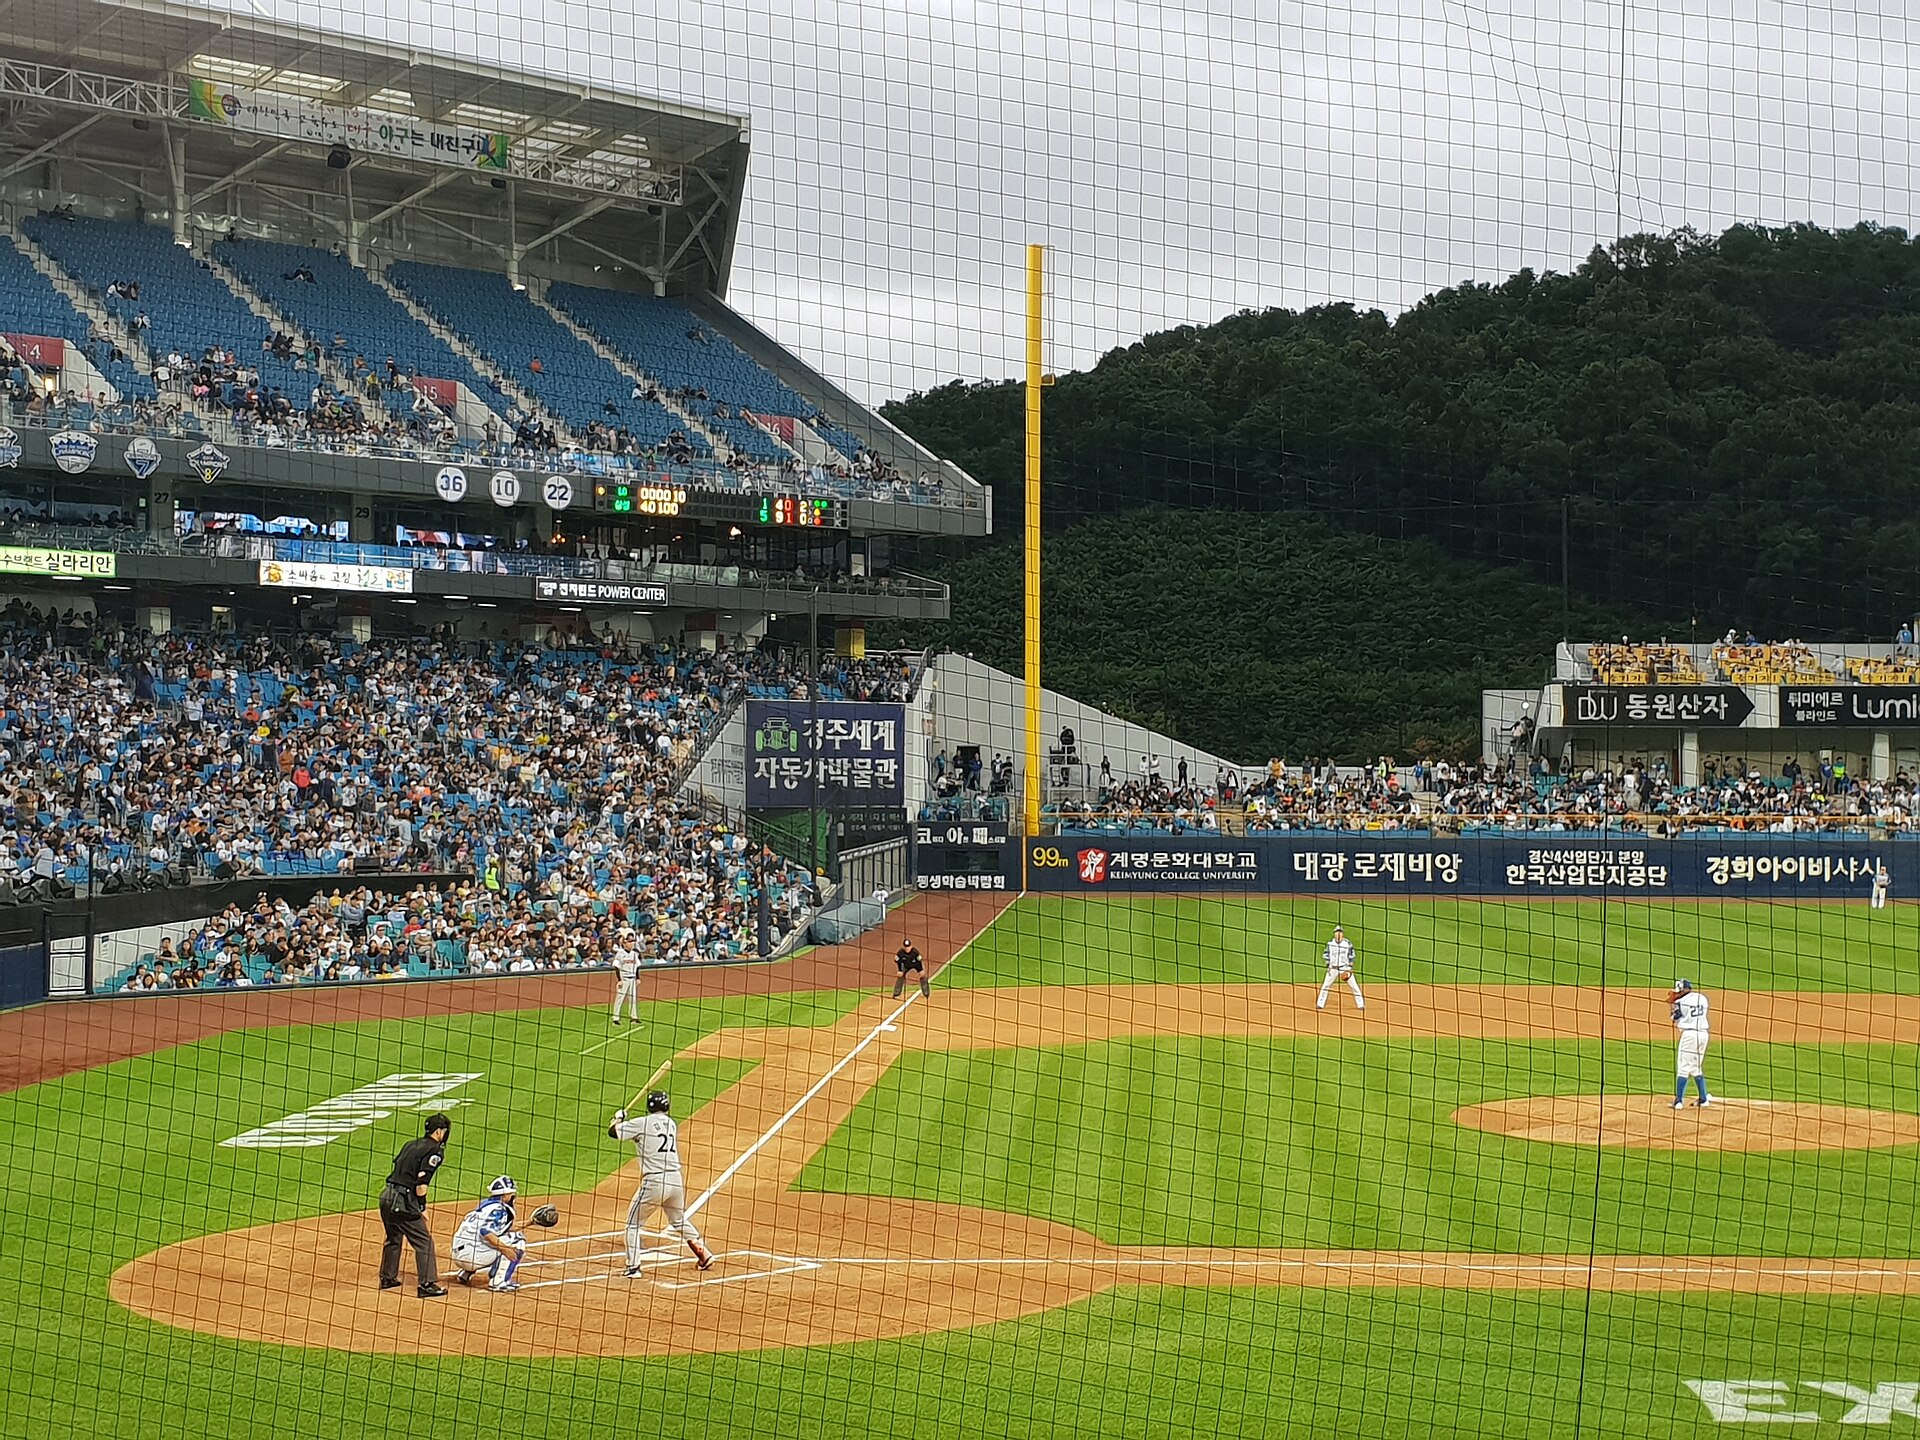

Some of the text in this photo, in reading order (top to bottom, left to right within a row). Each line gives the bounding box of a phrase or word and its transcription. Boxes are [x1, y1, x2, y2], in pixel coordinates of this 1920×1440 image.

[378, 124, 425, 147] 야구는
[21, 343, 42, 360] 14
[422, 384, 438, 400] 15
[440, 474, 463, 493] 36
[495, 478, 515, 497] 10
[547, 483, 569, 501] 22
[153, 492, 170, 504] 27
[355, 506, 370, 519] 29
[45, 552, 112, 574] 실라리안
[598, 584, 631, 599] POWER
[631, 586, 666, 602] CENTER
[1625, 693, 1729, 721] 동원산자
[1852, 693, 1920, 719] Lumi
[1109, 851, 1258, 869] 계명문화대학교
[1109, 871, 1257, 880] KEIMYUNG COLLEGE UNIVERSITY
[1505, 864, 1668, 887] 한국산업단지공단
[1705, 855, 1881, 885] 경희아이비샤시
